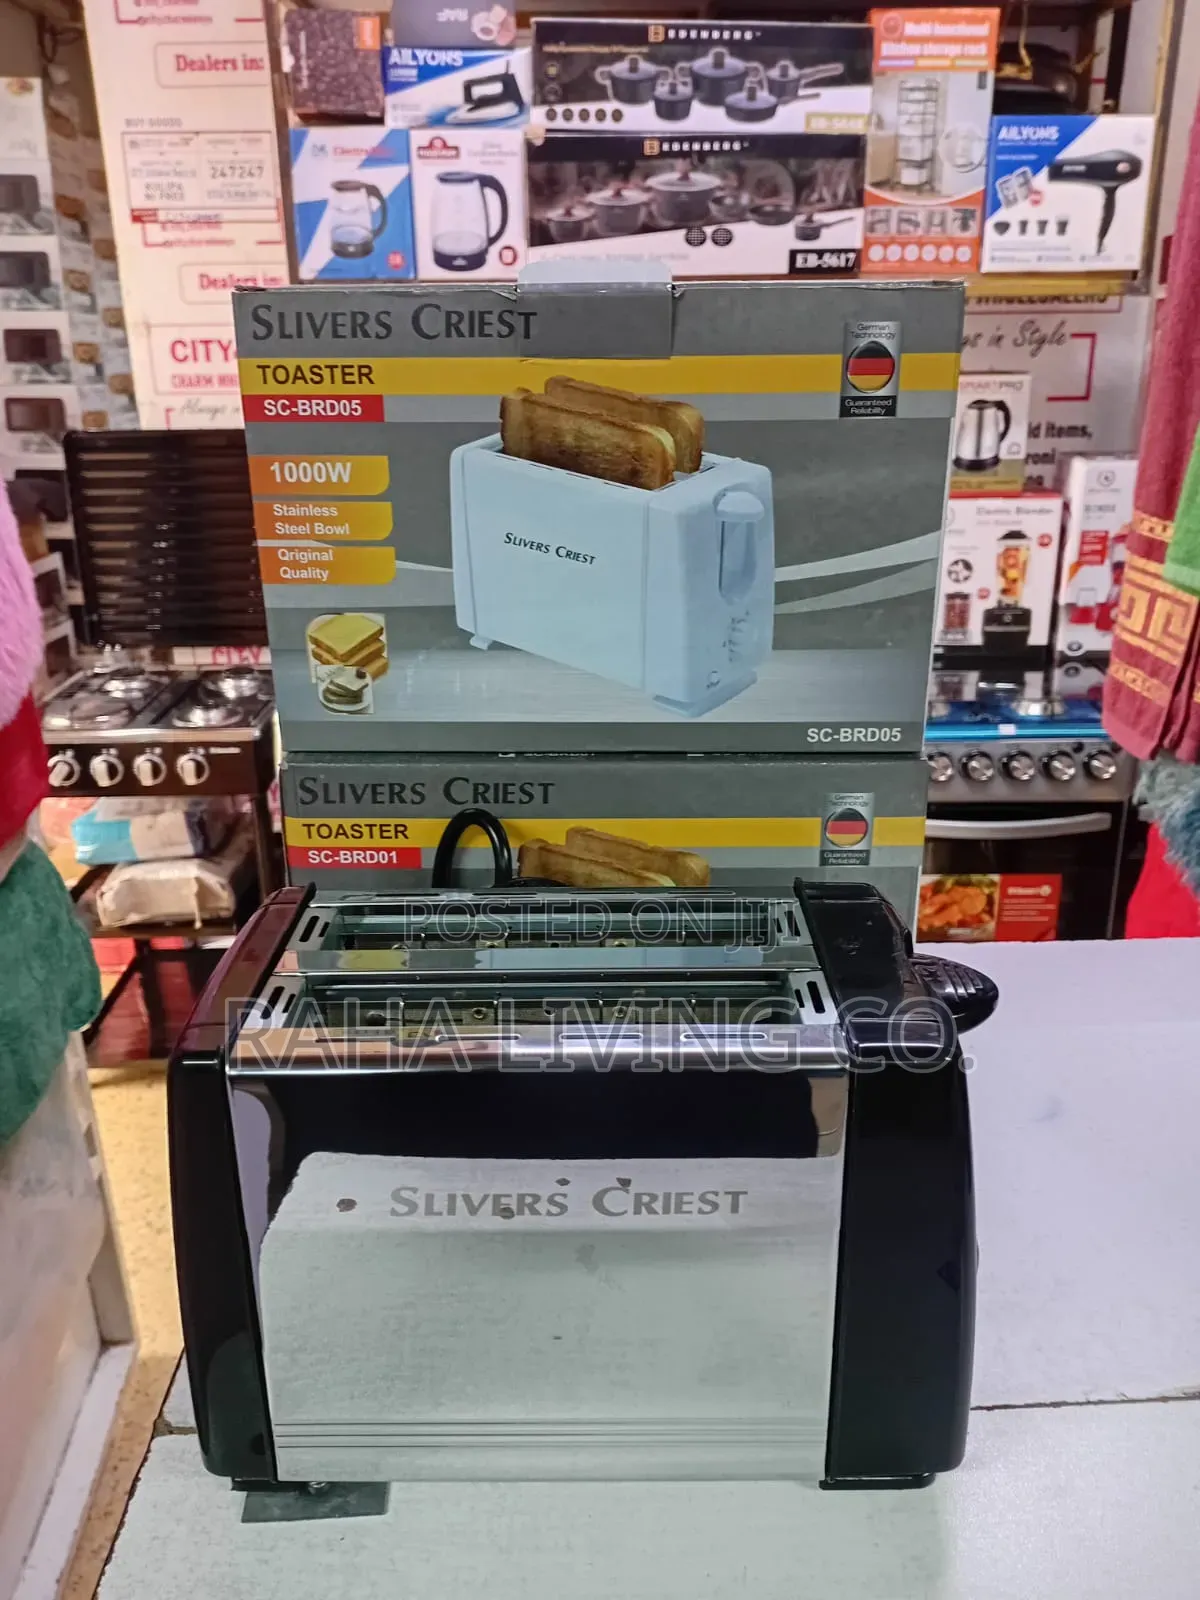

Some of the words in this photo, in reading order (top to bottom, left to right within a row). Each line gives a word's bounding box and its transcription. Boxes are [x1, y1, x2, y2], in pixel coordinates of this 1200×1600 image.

[175, 54, 239, 72] Dealers
[242, 53, 265, 70] in:
[388, 47, 464, 67] AILYONS
[998, 125, 1060, 141] AILYONS
[251, 303, 393, 341] SLIVERS
[411, 303, 538, 341] CRIEST
[857, 323, 890, 332] German
[850, 331, 897, 341] Technology
[1011, 318, 1068, 358] Style
[256, 364, 375, 386] TOASTER
[263, 399, 363, 417] SC-BRD05
[1045, 421, 1093, 440] items,
[270, 461, 353, 484] 1000W
[273, 503, 339, 517] Stainless
[275, 522, 311, 535] Steel
[314, 522, 351, 535] Bowl
[503, 531, 551, 554] SLIVERS
[555, 545, 597, 566] CRIEST
[279, 566, 330, 582] Quality
[806, 727, 903, 743] SC-BRD05
[299, 776, 427, 806] SLIVERS
[443, 776, 556, 806] CRIEST
[302, 823, 410, 840] TOASTER
[307, 850, 399, 865] SC-BRD01
[390, 1186, 569, 1218] SLIVERS
[591, 1186, 749, 1218] CRIEST
